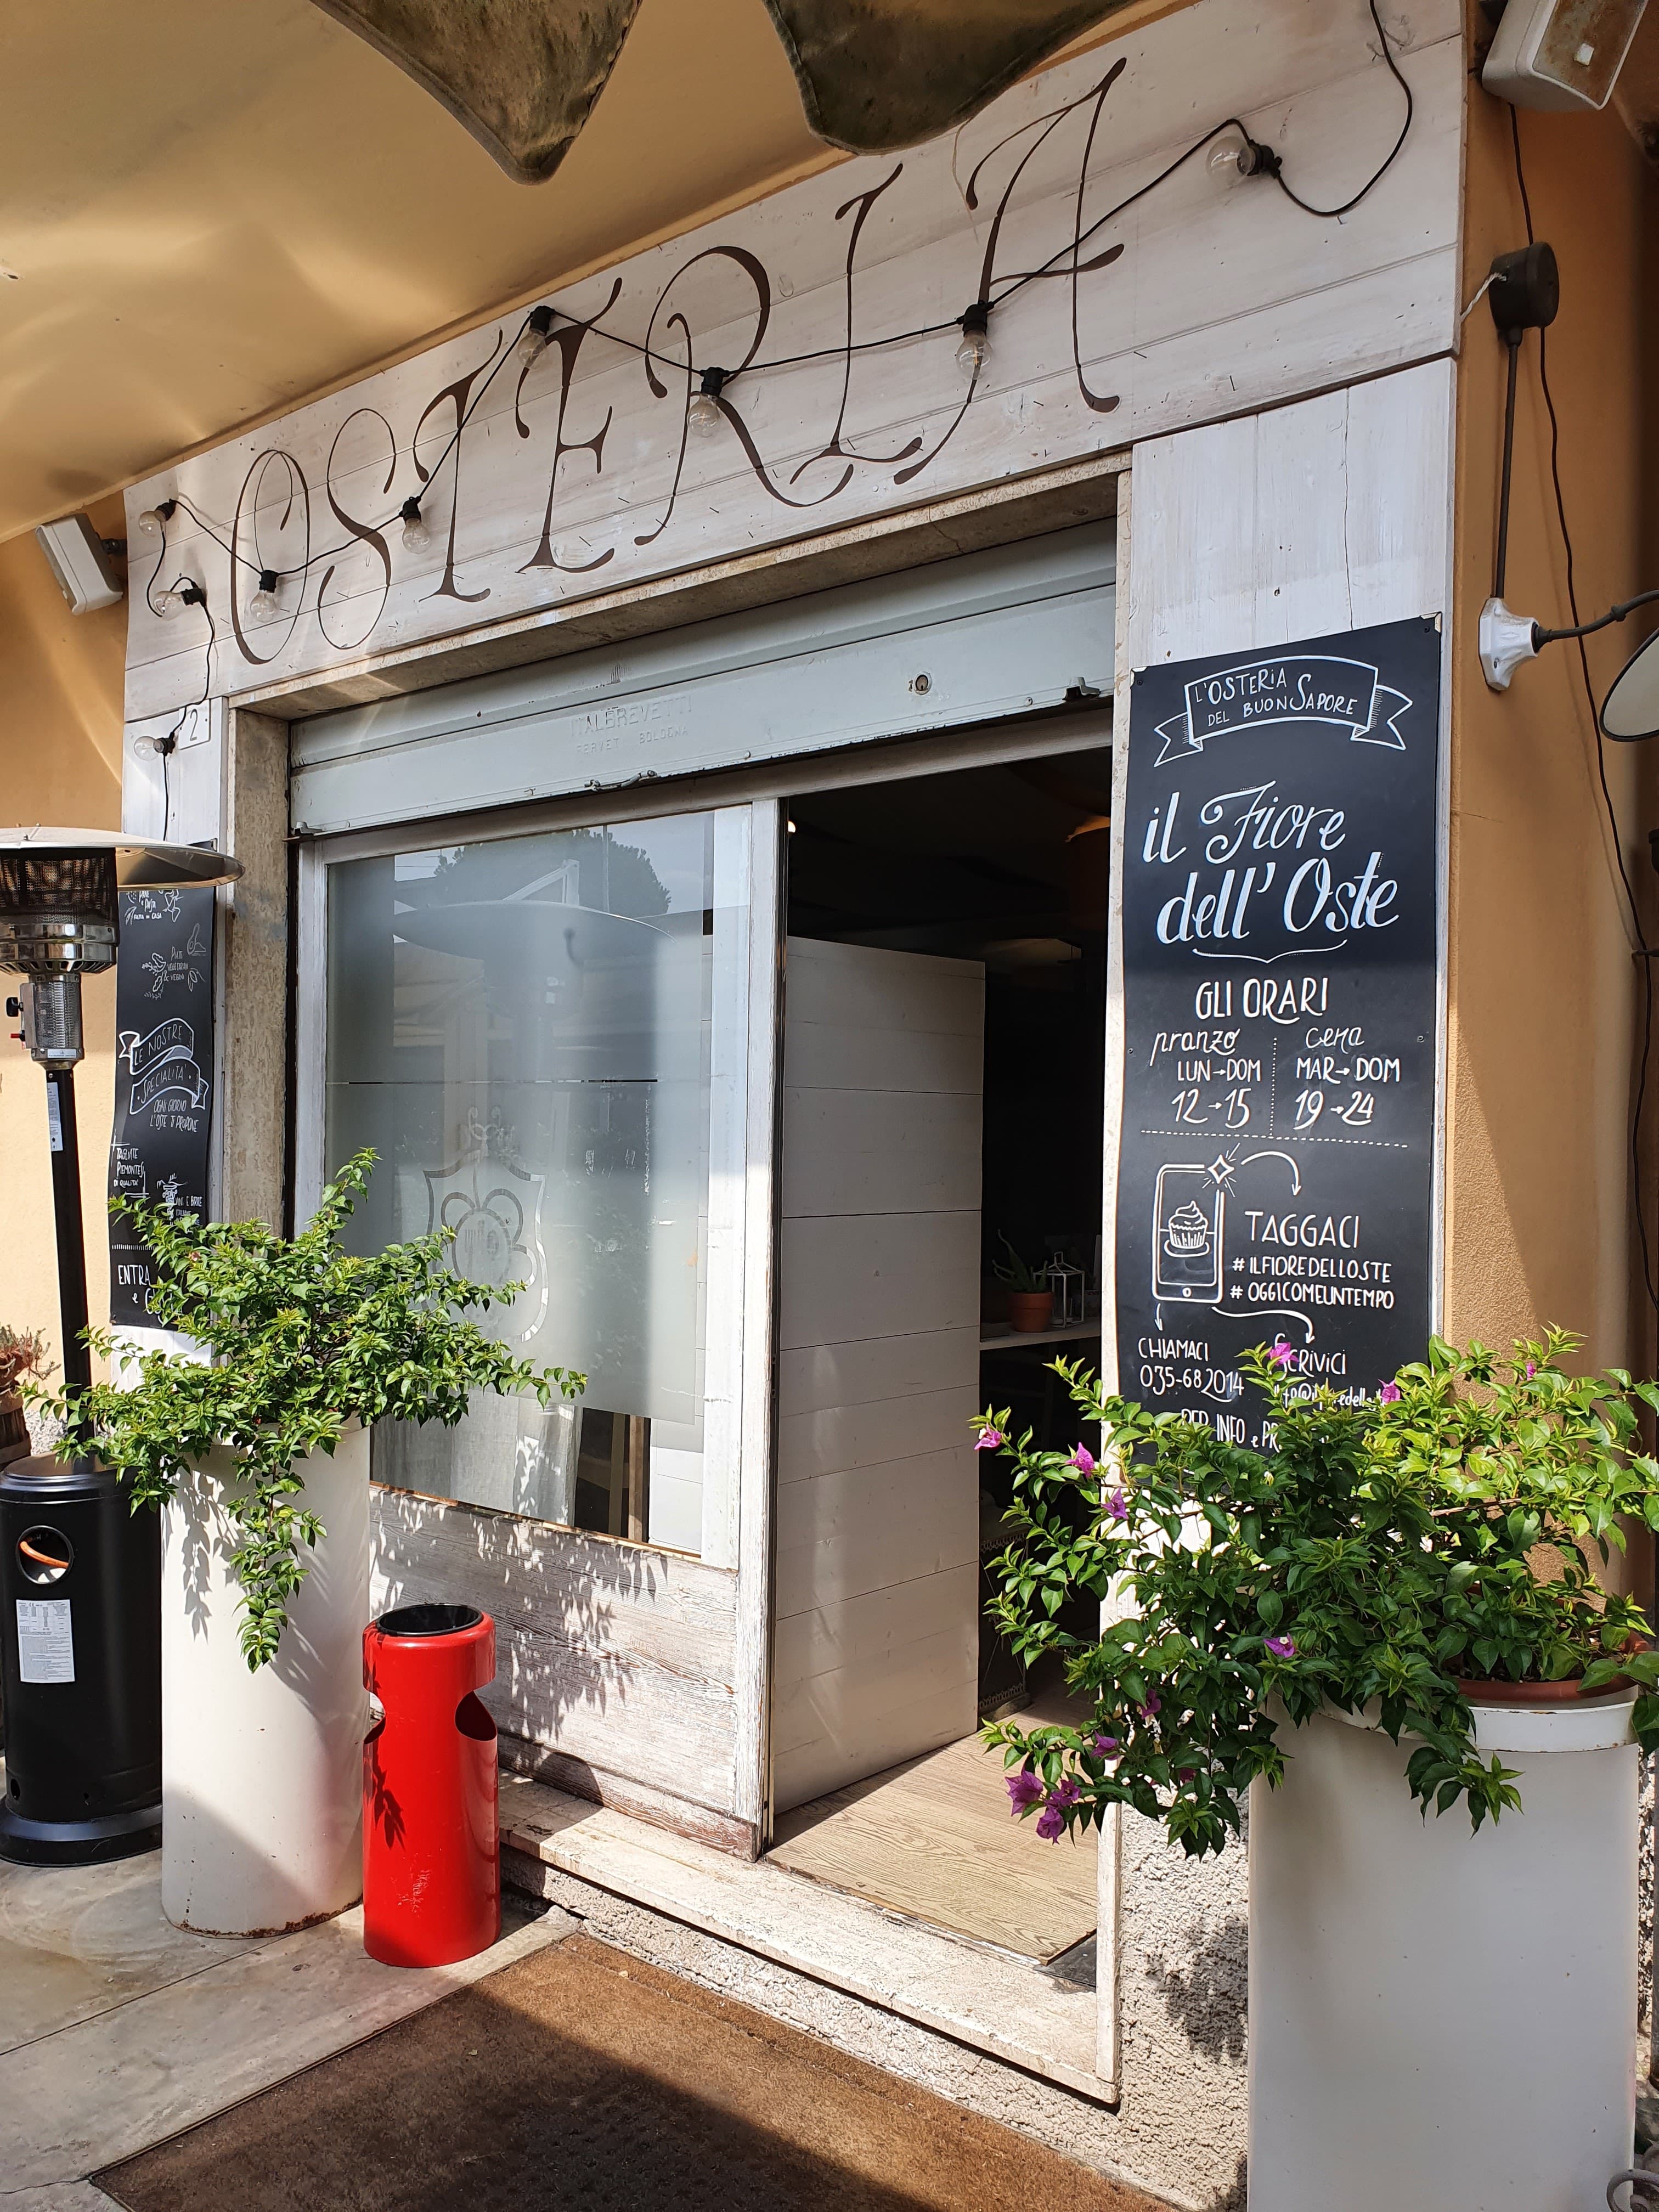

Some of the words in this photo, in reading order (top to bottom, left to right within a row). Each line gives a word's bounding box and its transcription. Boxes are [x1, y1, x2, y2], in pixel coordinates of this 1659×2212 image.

[230, 58, 1127, 665] OSTERIA
[1207, 711, 1229, 726] DEL
[1143, 792, 1187, 863] il
[1200, 780, 1345, 864] Fiore
[1195, 980, 1231, 1019] GLI
[1243, 977, 1328, 1024] ORARI
[134, 1048, 143, 1065] LE
[148, 1024, 182, 1056] NOSTRE
[1149, 1029, 1240, 1066] pranzo
[1177, 1060, 1211, 1082] LUN
[1226, 1059, 1261, 1082] DOM
[1296, 1057, 1340, 1084] MAR
[1356, 1058, 1400, 1082] DOM
[168, 1099, 187, 1112] GIORNO
[1172, 1088, 1207, 1124] 12
[1224, 1088, 1252, 1128] 15
[1293, 1091, 1324, 1130] 19
[1342, 1091, 1374, 1126] 24
[176, 1115, 199, 1132] PROPONE
[116, 1148, 139, 1160] TAGLIATE
[117, 1161, 144, 1178] PIEMONTESI
[1244, 1211, 1359, 1248] TAGGACI
[118, 1265, 151, 1286] ENTRA
[1138, 1338, 1209, 1361] CHIAMACI
[1216, 1413, 1245, 1444] INFO
